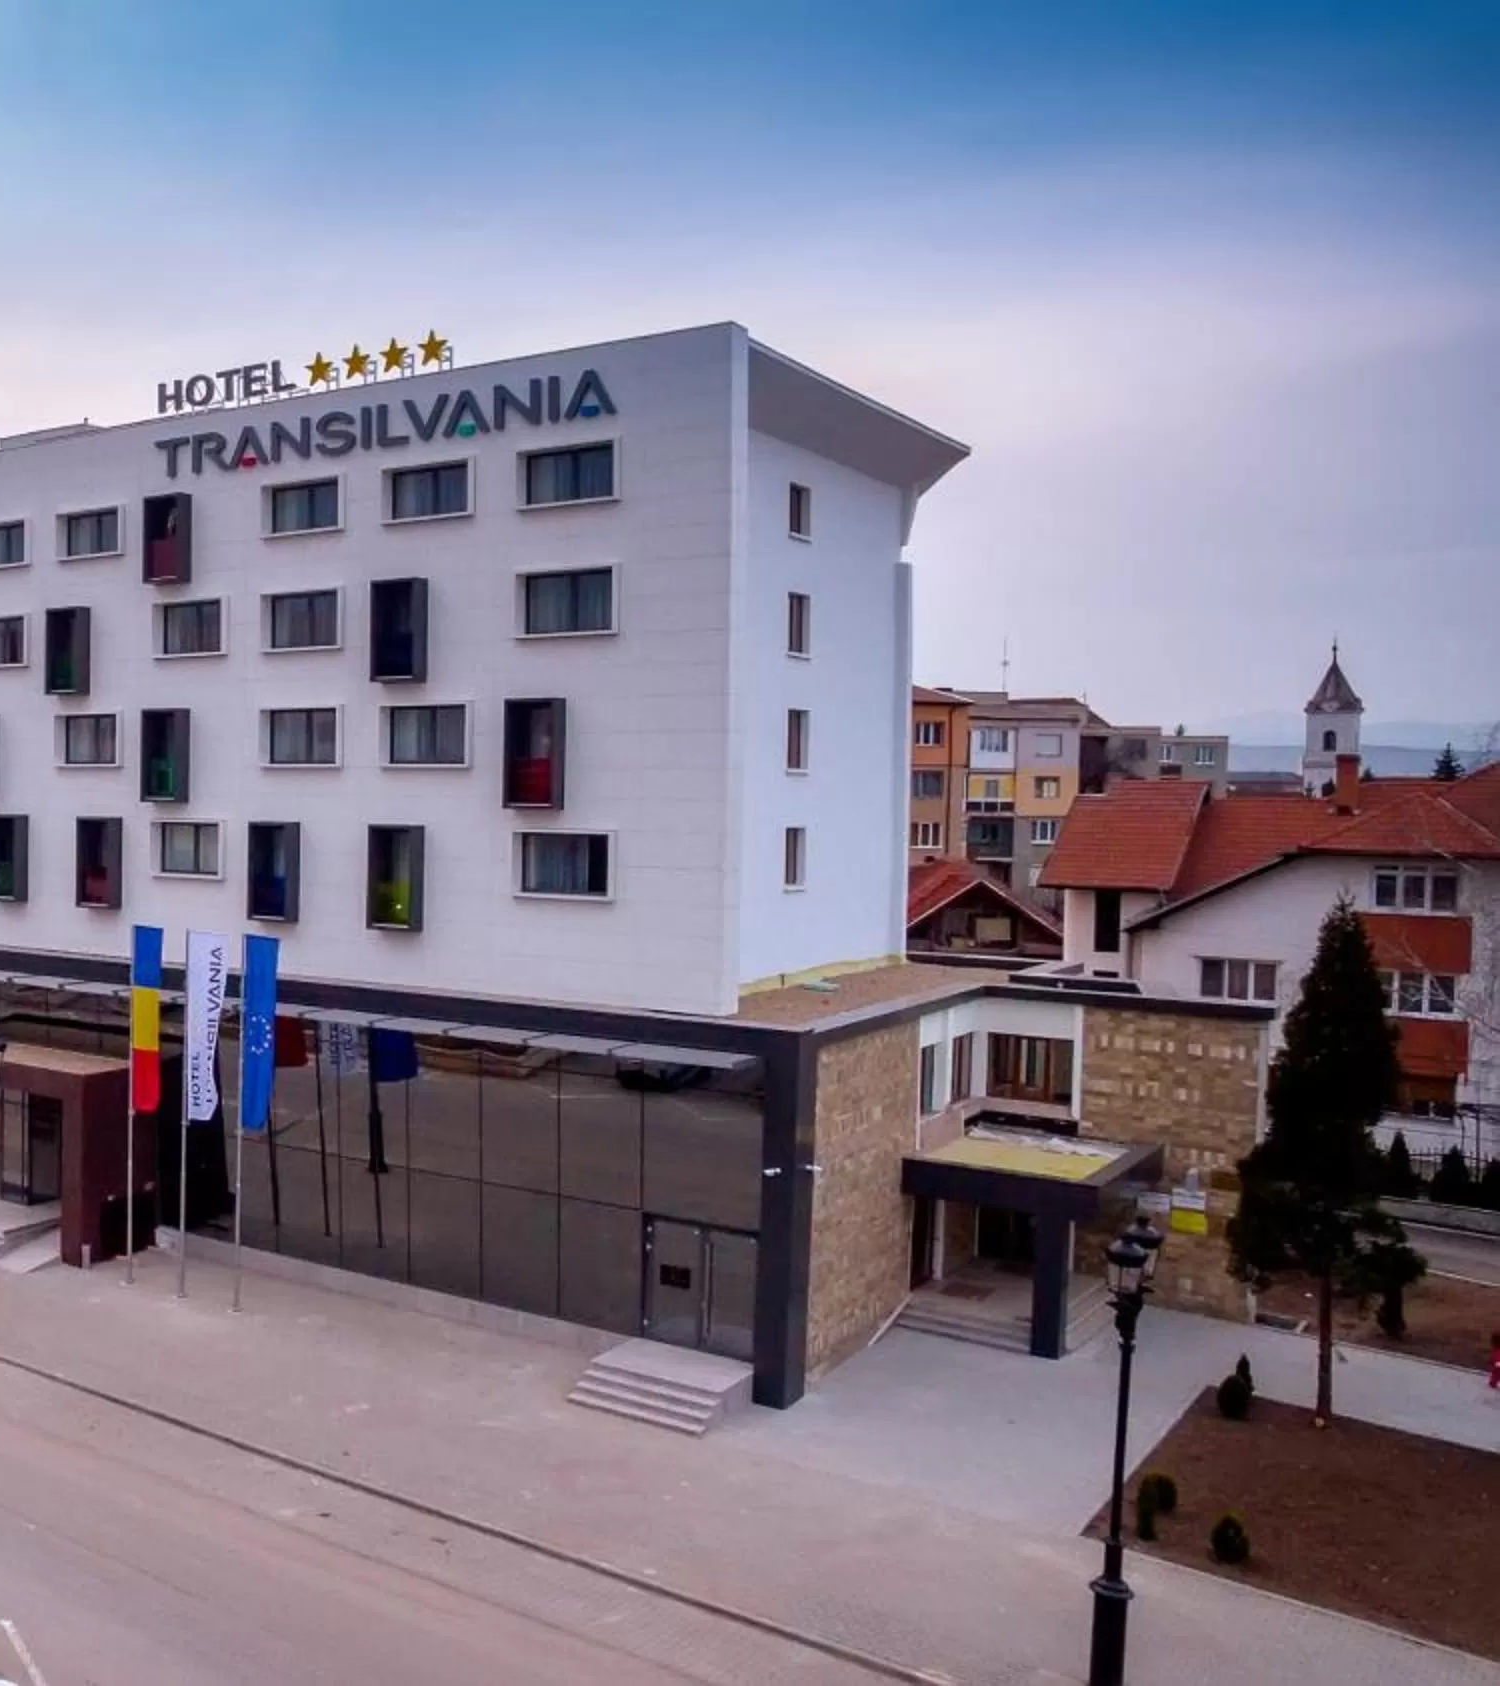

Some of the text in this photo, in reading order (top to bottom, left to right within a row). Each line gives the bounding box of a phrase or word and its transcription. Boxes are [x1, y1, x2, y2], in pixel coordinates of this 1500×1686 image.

[155, 368, 617, 478] TRANSILVANIA
[157, 360, 296, 414] HOTEL
[205, 945, 224, 1104] SILVANIA
[191, 1051, 202, 1107] HOTEL
